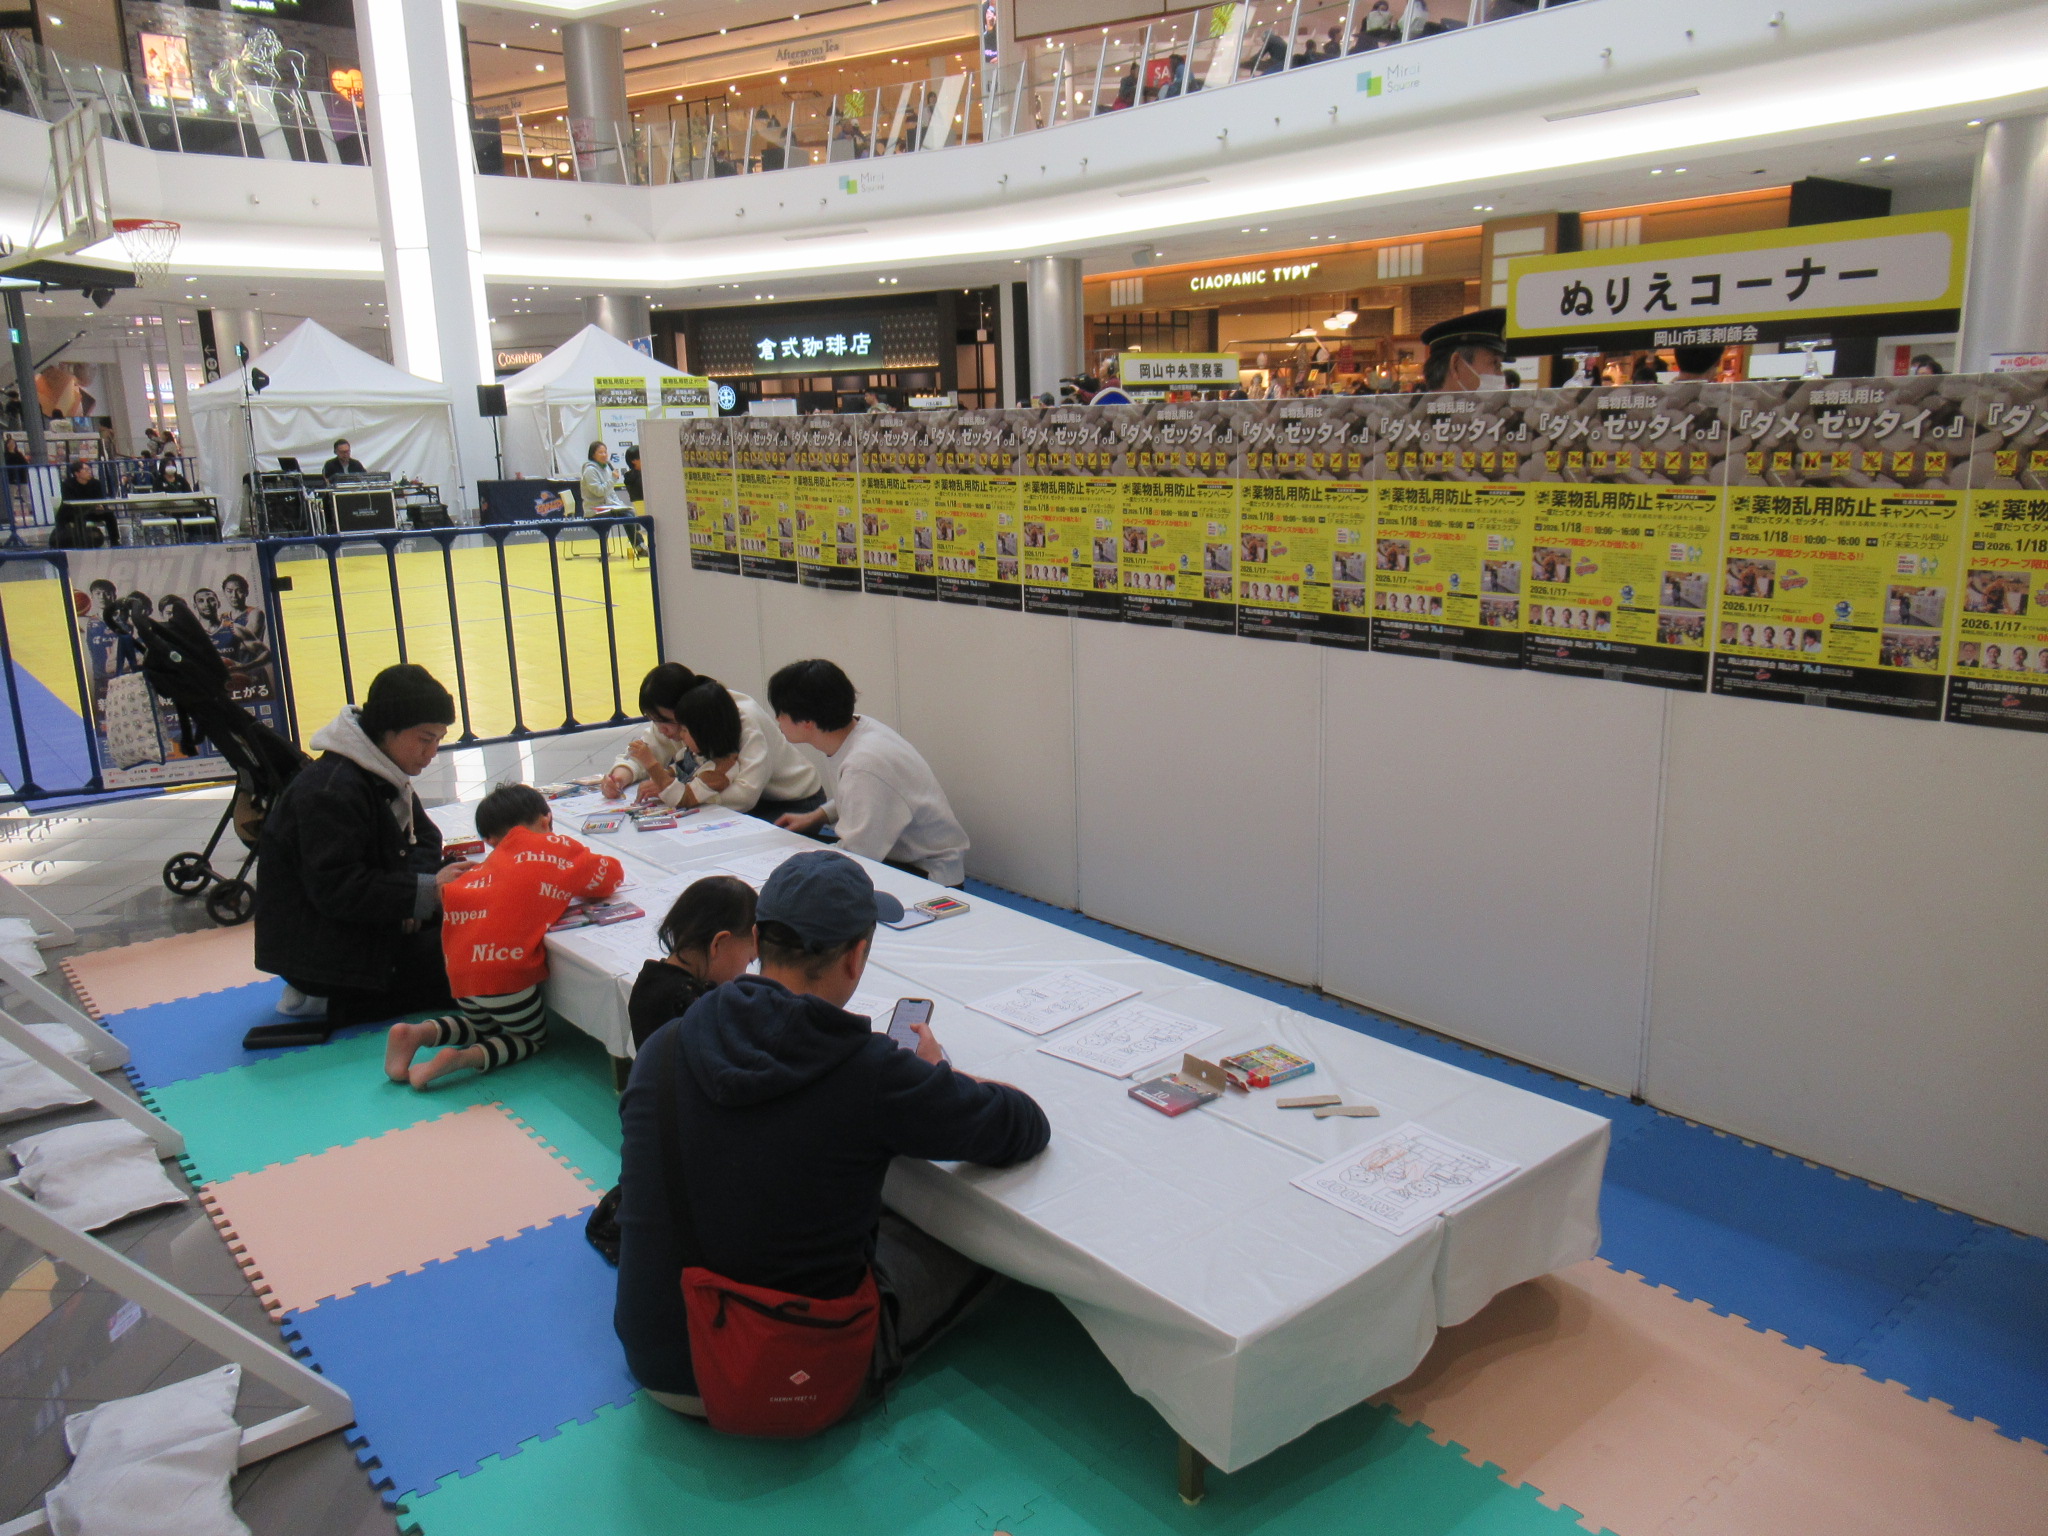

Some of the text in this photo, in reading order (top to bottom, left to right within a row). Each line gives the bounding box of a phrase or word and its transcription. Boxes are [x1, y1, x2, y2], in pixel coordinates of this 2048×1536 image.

[822, 38, 840, 54] Tea
[1154, 66, 1170, 80] SA
[1190, 269, 1266, 291] CIAOPANIC
[1560, 257, 1879, 317] ぬりえコーナー
[1654, 326, 1758, 346] 岡山市薬剤師会
[757, 332, 871, 360] 倉式珈琲店
[1140, 363, 1223, 378] 岡山中央警察署
[1597, 395, 1658, 409] 薬物乱用は
[1809, 388, 1885, 405] 薬物乱用は
[1427, 402, 1476, 414] 薬物乱用は
[1121, 423, 1233, 444] 『ダメ。ゼッタイ。』
[1243, 421, 1369, 444] 『ダメ。ゼッタイ。』
[1380, 417, 1527, 442] 『ダメ。ゼッタイ。』
[1540, 413, 1720, 440] 『ダメ。ゼッタイ。』
[1740, 409, 1965, 440] 『ダメ。ゼッタイ。』
[1022, 426, 1115, 446] 『ダメ。ゼッタイ。』
[941, 480, 988, 492] 薬物乱用防止
[1032, 481, 1084, 494] 薬物乱用防止
[1132, 482, 1195, 497] 薬物乱用防止
[1253, 485, 1322, 501] 薬物乱用防止
[1392, 487, 1525, 506] 薬物乱用防止 キャンペーン
[1551, 490, 1716, 513] 薬物乱用防止 キャンペーン
[1752, 495, 1956, 520] 薬物乱用防止 キャンペーン
[1561, 522, 1582, 533] 1/18
[1763, 530, 1788, 543] 1/18
[1987, 541, 2014, 551] 2026.
[2016, 539, 2048, 552] 1/18
[1722, 601, 1769, 613] 2026.1/17
[1961, 618, 2021, 632] 2026.1/17
[546, 834, 571, 847] Ok
[514, 850, 575, 870] Things
[586, 857, 609, 891] Nice
[538, 881, 573, 900] Nice
[443, 908, 488, 925] appen
[470, 942, 524, 962] Nice
[1316, 1179, 1404, 1223] TRYHOOP
